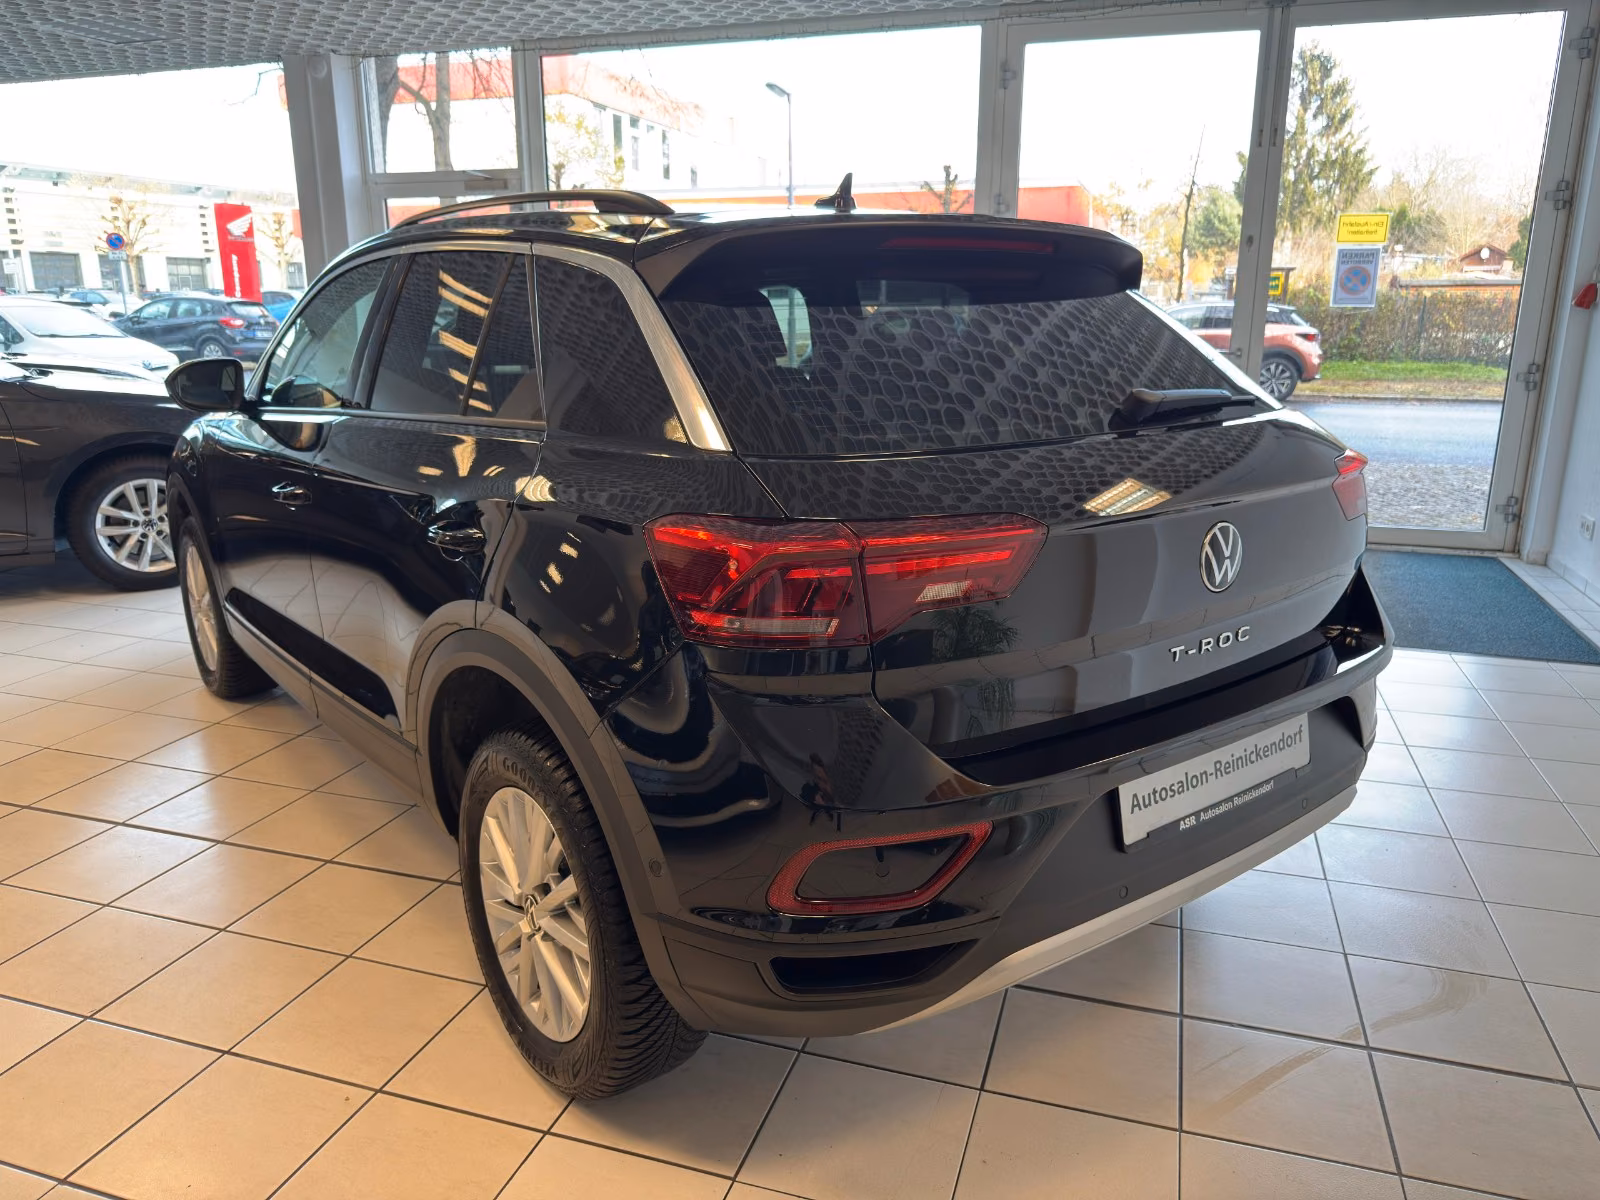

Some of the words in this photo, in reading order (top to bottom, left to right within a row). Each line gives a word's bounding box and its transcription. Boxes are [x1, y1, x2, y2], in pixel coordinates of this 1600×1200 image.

[1169, 626, 1250, 662] T-ROC
[1130, 724, 1303, 815] Autosalon-Reinickendorf
[1179, 816, 1197, 831] ASR
[1199, 802, 1233, 822] Autosalon
[1233, 780, 1275, 806] Reinickendorf
